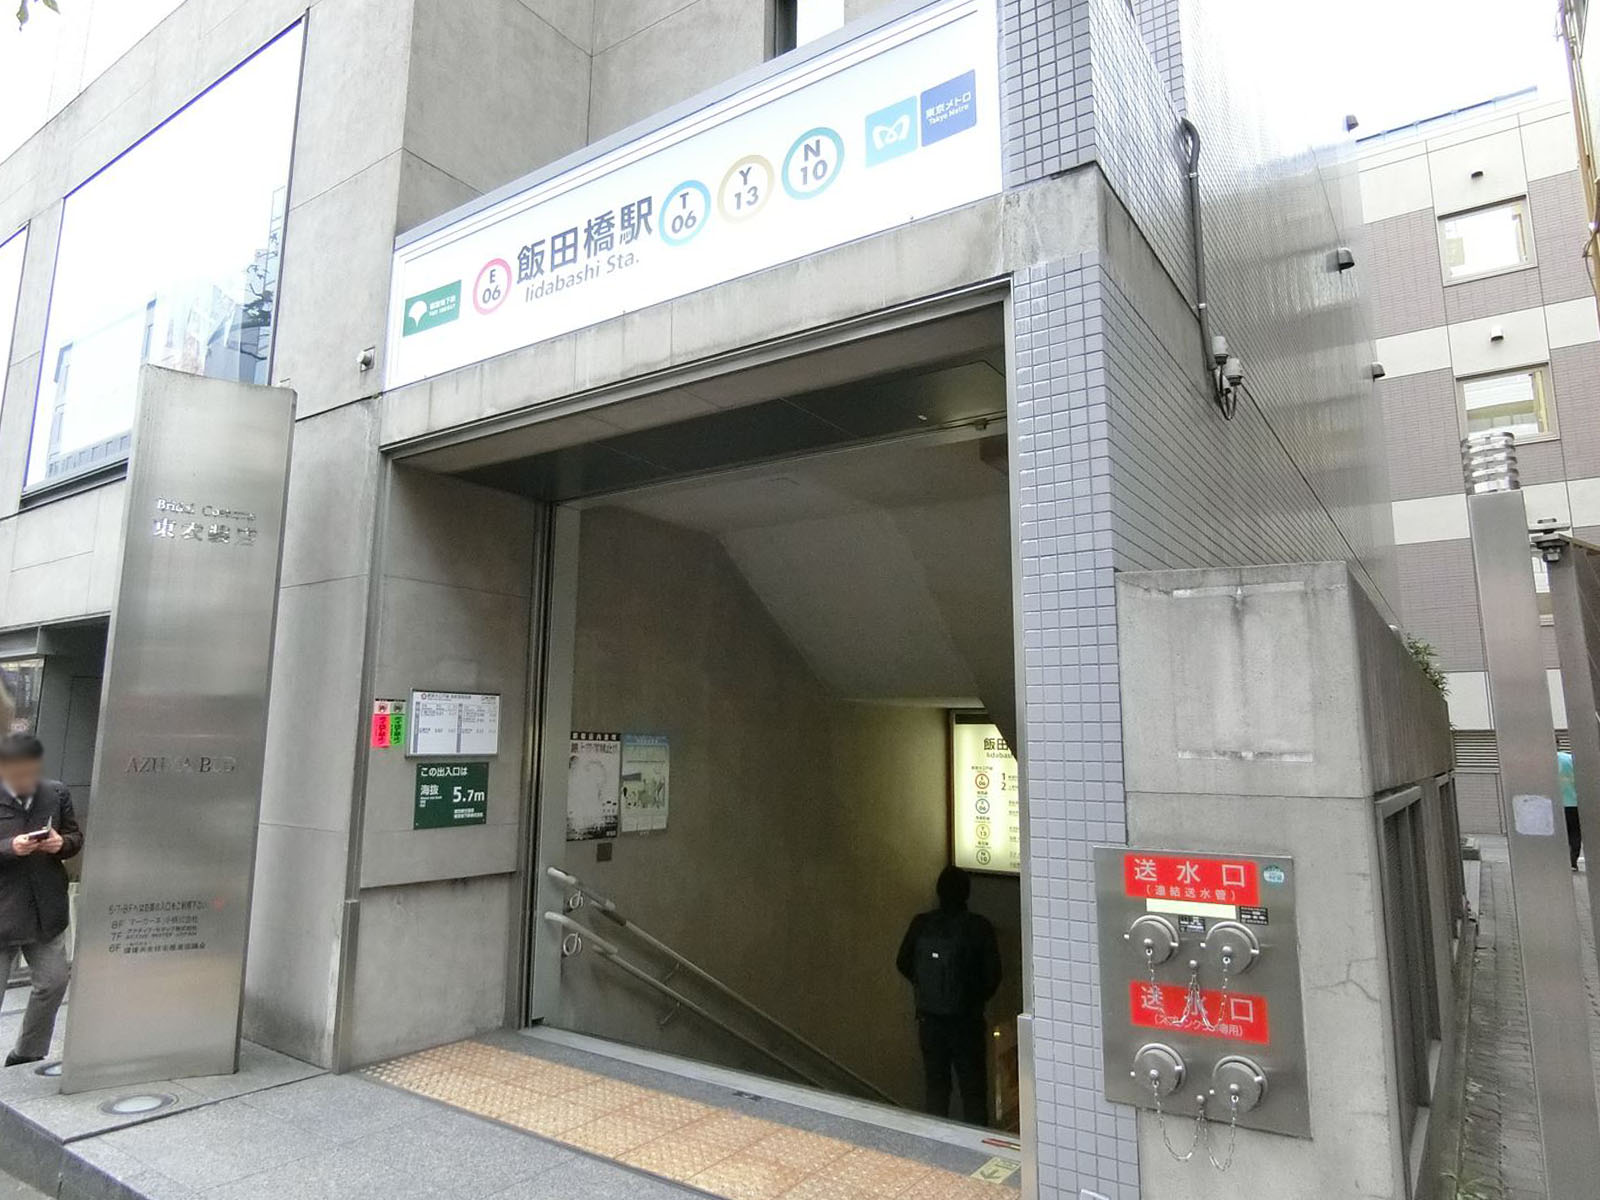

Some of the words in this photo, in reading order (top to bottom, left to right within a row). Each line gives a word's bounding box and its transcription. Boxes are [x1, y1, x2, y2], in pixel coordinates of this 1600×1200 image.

[926, 91, 972, 119] 東京メトロ
[804, 139, 821, 162] N
[739, 167, 752, 186] Y
[801, 159, 828, 185] 10
[679, 192, 689, 210] T
[734, 186, 759, 211] 13
[671, 211, 697, 234] 06
[516, 196, 653, 285] 飯田橋駅
[489, 268, 496, 284] E
[525, 264, 600, 303] Iidabashi
[606, 251, 640, 275] Sta.
[482, 286, 501, 304] 06
[126, 756, 193, 773] AZUA
[421, 766, 468, 777] この出入口は
[420, 784, 440, 796] 海抜
[452, 786, 485, 802] 5.7m
[1001, 782, 1006, 791] 2
[1133, 858, 1245, 888] 送水口
